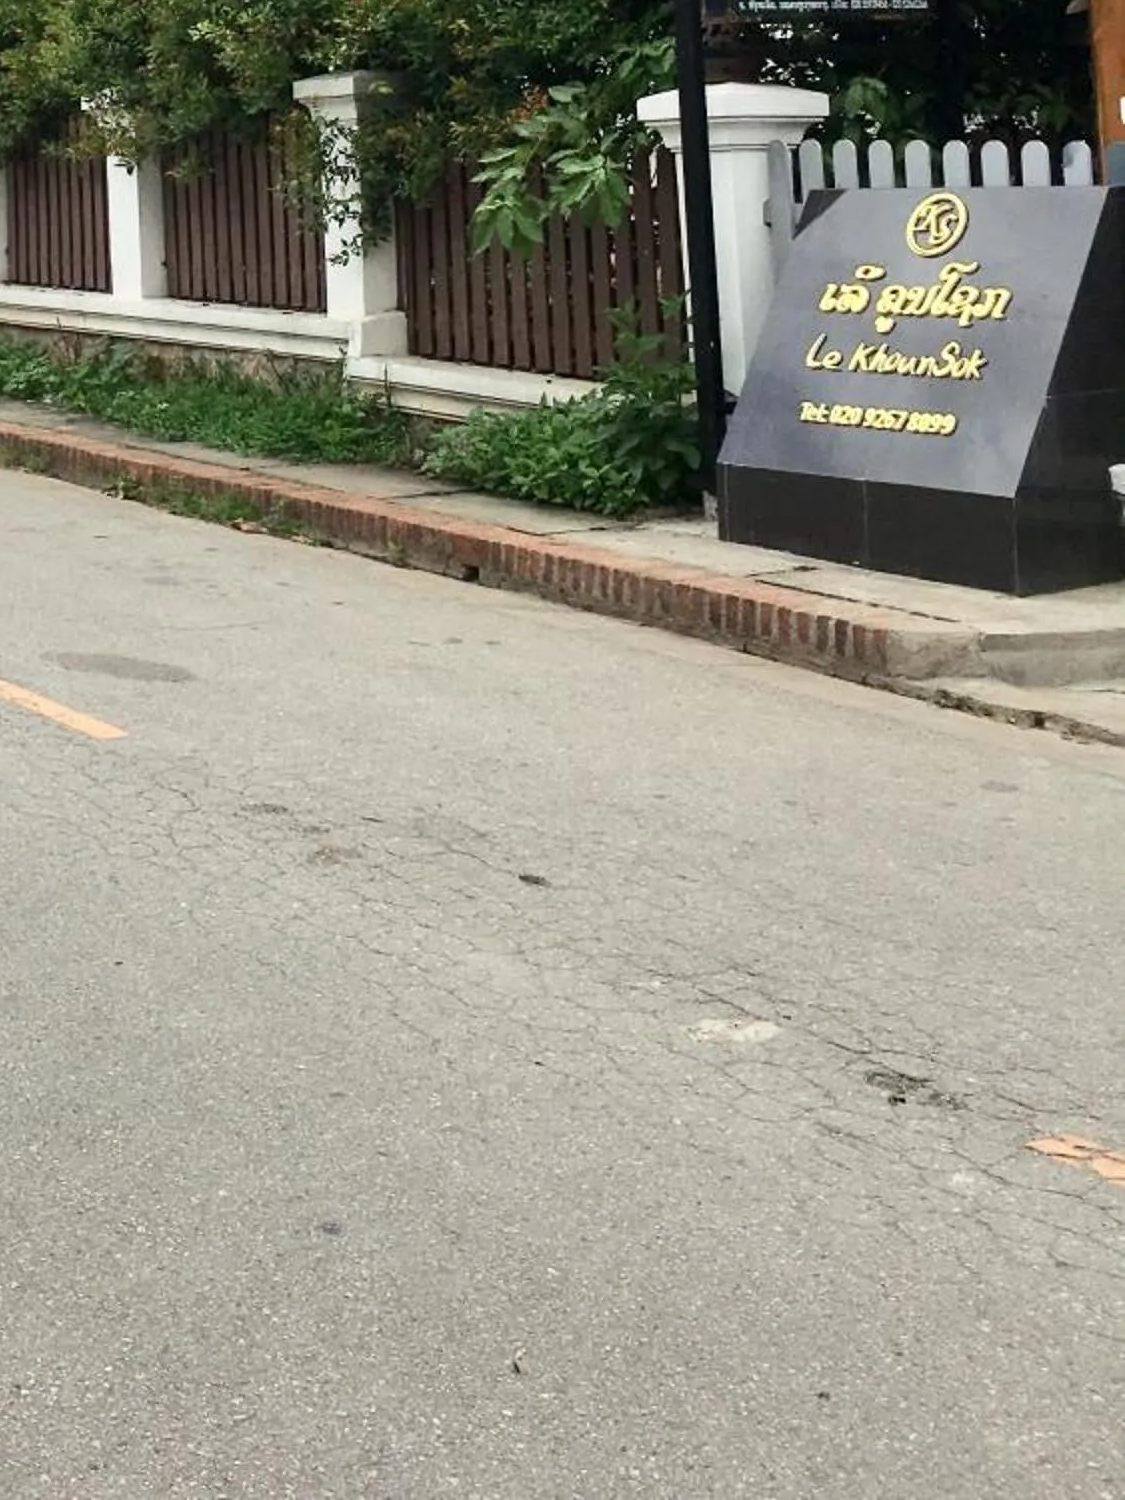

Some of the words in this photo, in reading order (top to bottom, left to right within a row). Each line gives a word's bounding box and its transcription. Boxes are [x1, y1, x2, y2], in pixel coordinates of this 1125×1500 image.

[805, 333, 843, 370] Le
[828, 404, 863, 426] 020
[863, 407, 909, 431] 9267
